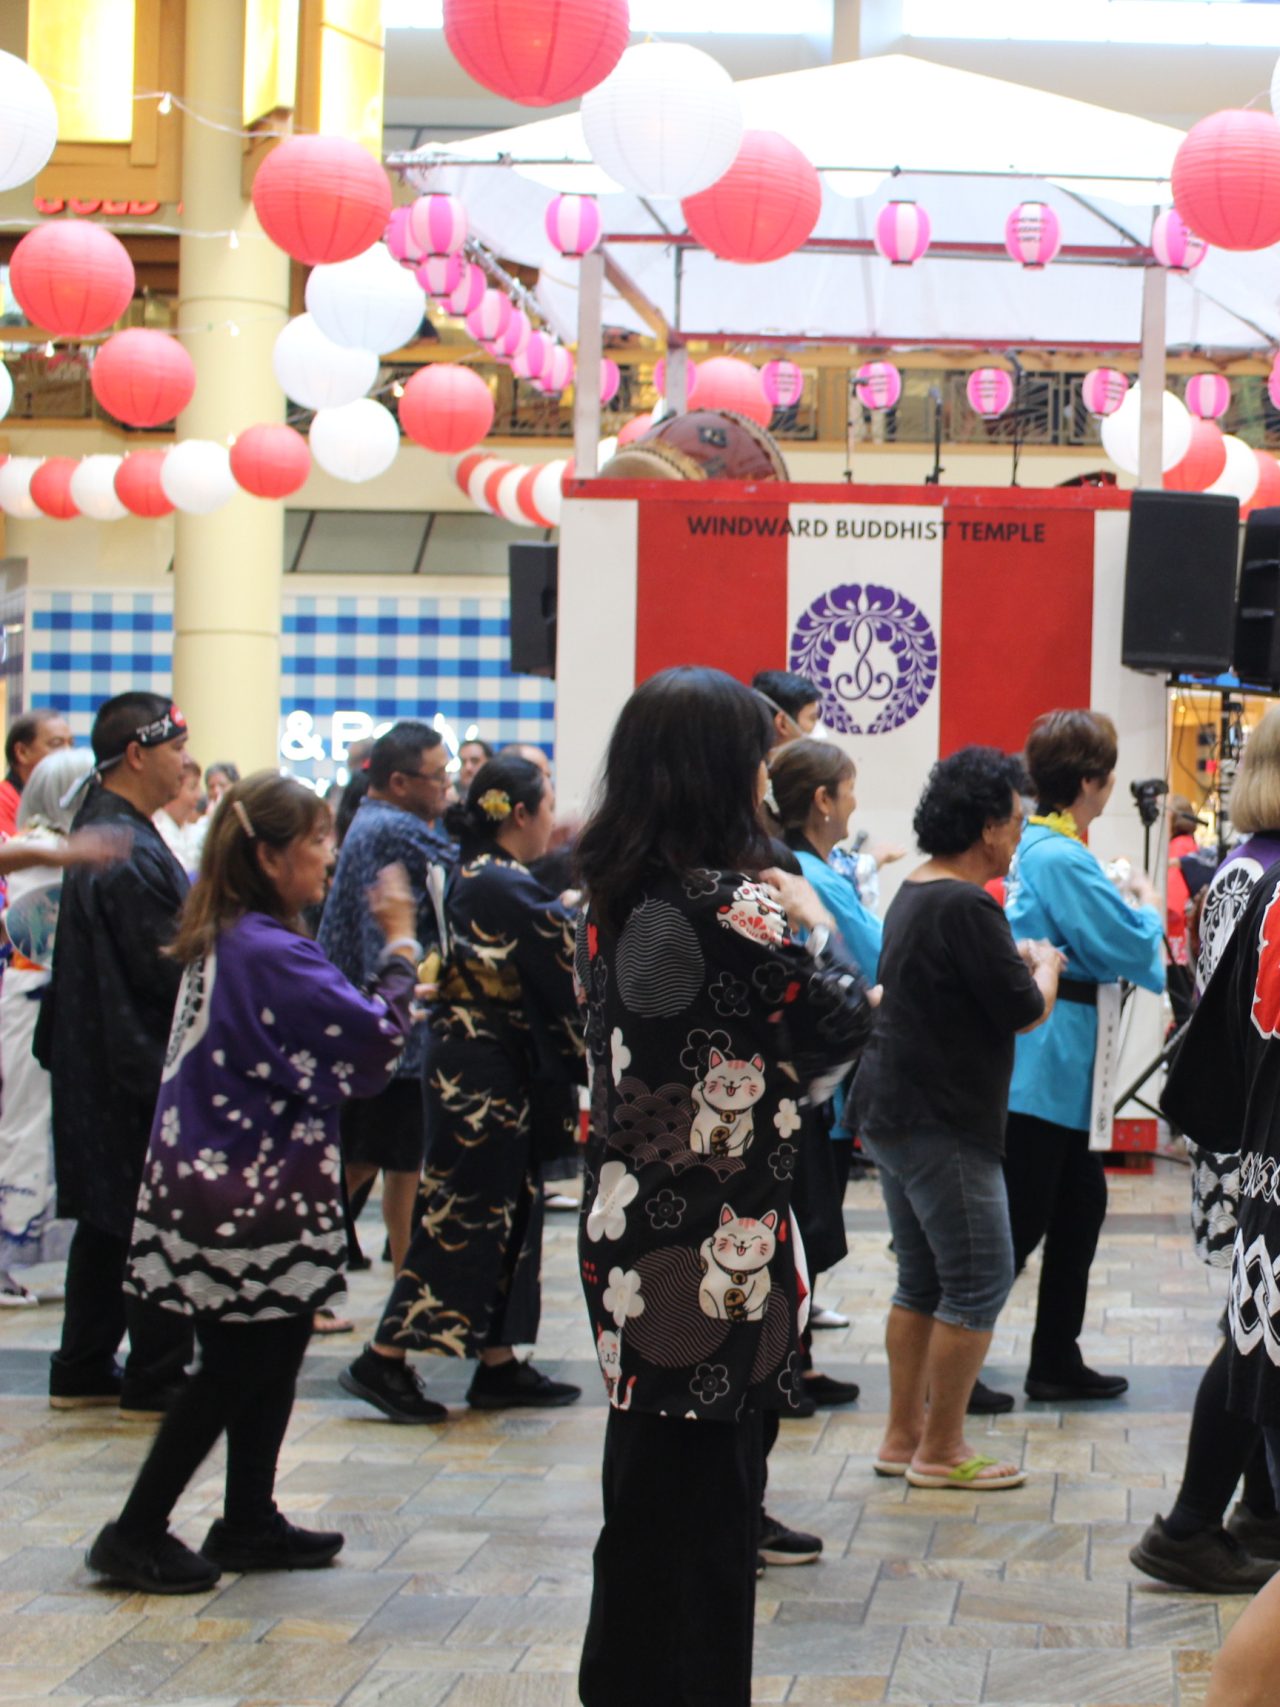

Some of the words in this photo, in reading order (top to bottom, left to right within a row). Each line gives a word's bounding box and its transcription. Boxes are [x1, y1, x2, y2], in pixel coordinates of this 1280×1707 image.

[687, 516, 828, 538] WINDWARD
[835, 520, 950, 541] BUDDHIST
[958, 522, 1045, 543] TEMPLE
